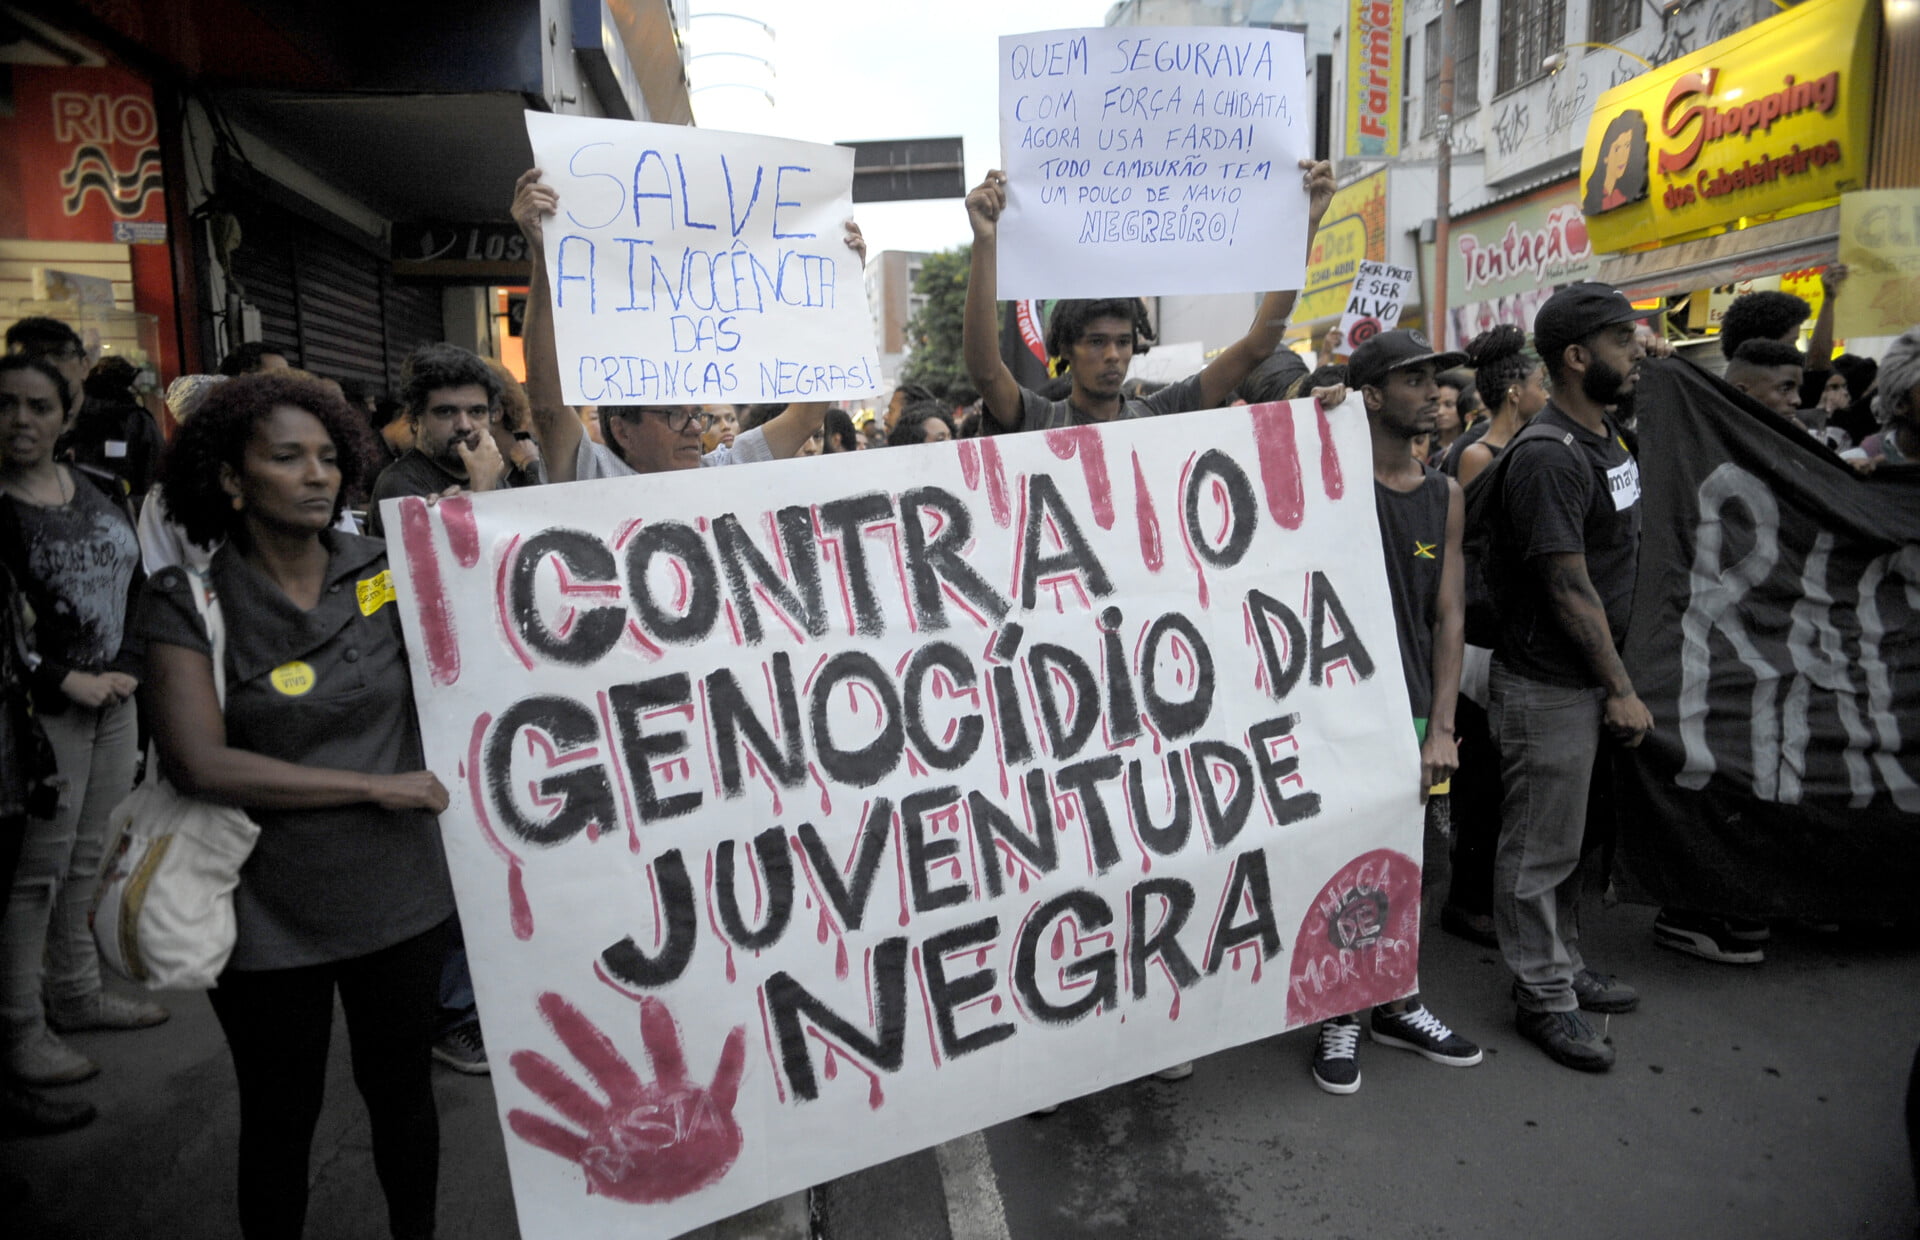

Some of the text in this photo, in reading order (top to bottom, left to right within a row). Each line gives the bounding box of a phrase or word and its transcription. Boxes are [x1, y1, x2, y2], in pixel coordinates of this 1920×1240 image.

[1011, 36, 1272, 81] QUEM SEGURAVA
[53, 92, 158, 146] RIO
[1015, 89, 1076, 122] COM
[1101, 85, 1181, 121] FORÇA
[1193, 88, 1204, 117] A
[1657, 68, 1839, 175] Shopping
[1021, 123, 1253, 153] AGORA USA FARDA!
[567, 142, 816, 240] SALVE
[1038, 155, 1272, 181] TODO CAMBURÃO TEM
[1663, 139, 1840, 210] dos Cabeleireiros
[1040, 186, 1067, 205] UM
[1079, 186, 1132, 204] POUCO
[1146, 186, 1170, 203] DE
[557, 235, 835, 314] A INOCÊNCIA
[1359, 262, 1383, 277] SER
[1369, 280, 1400, 298] SER
[1348, 296, 1398, 321] ALVO
[670, 315, 741, 355] DAS
[579, 356, 876, 401] CRIANÇAS NEGRAS!
[509, 448, 1258, 668] CONTRA O
[1245, 571, 1376, 702] DA
[600, 711, 1321, 989] JUVENTUDE
[1307, 859, 1391, 936] CHEGA
[1337, 904, 1381, 947] DE
[764, 848, 1285, 1105] NEGRA
[1291, 936, 1410, 1007] MORTES
